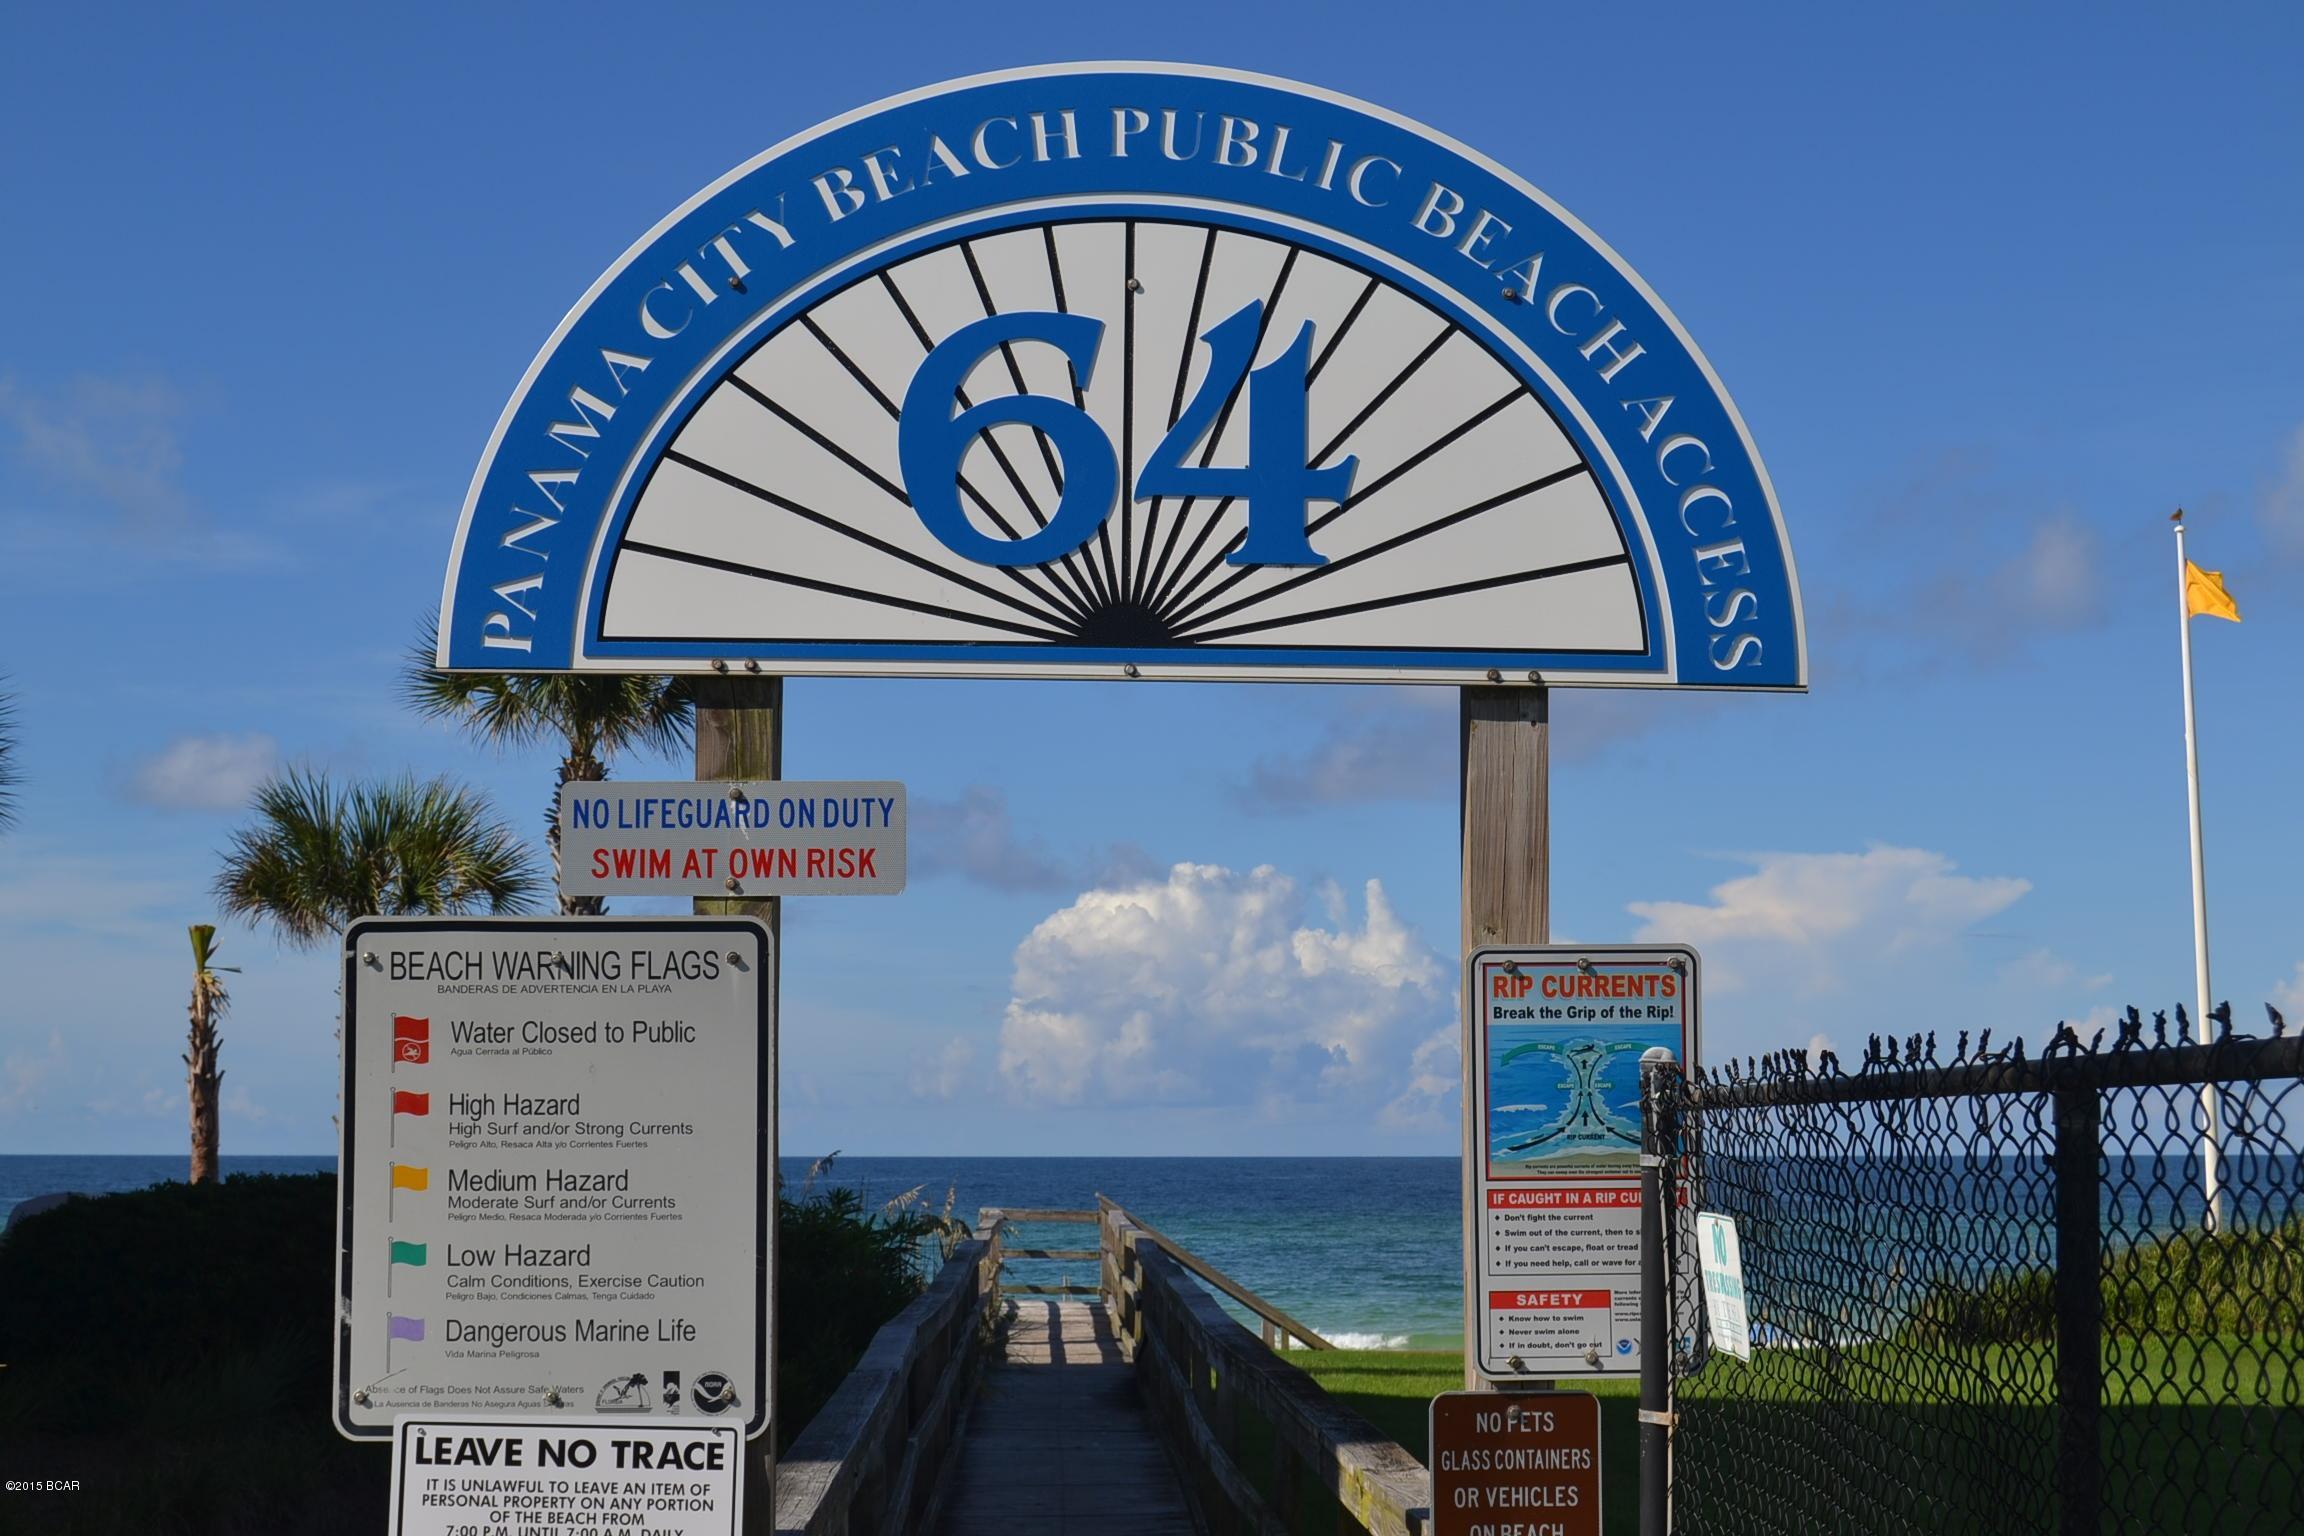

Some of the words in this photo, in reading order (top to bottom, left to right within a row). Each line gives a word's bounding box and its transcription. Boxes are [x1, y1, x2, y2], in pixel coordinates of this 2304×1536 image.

[482, 347, 655, 654] PANAMA
[638, 192, 797, 340] CITY
[812, 107, 1082, 223] BEACH
[1108, 106, 1403, 208] PUBLIC
[1409, 180, 1647, 384] BEACH
[1622, 394, 1763, 671] ACCESS
[898, 298, 1360, 568] 64
[572, 799, 610, 829] NO
[618, 798, 770, 829] LIFEGUARD
[779, 798, 815, 828] ON
[823, 797, 895, 828] DUTY
[591, 848, 671, 879] SWIM
[682, 848, 718, 879] AT
[729, 848, 797, 879] OWN
[807, 848, 877, 878] RISK
[390, 951, 483, 981] BEACH
[492, 950, 621, 980] WARNING
[631, 950, 720, 980] FLAGS
[437, 984, 499, 994] BANDERAS
[502, 984, 518, 994] DE
[520, 984, 599, 994] ADVERTENCIA
[601, 984, 618, 994] EN
[620, 984, 635, 994] LA
[637, 984, 672, 993] PLAYA
[1493, 975, 1534, 999] RIP
[1541, 975, 1677, 999] CURRENTS
[1493, 1006, 1535, 1019] Break
[1539, 1006, 1563, 1019] the
[1566, 1006, 1596, 1021] Grip
[1600, 1005, 1615, 1018] of
[1619, 1005, 1642, 1018] the
[1646, 1005, 1674, 1021] Rip!
[450, 1020, 515, 1044] Water
[522, 1020, 597, 1044] Closed
[604, 1021, 625, 1044] to
[633, 1020, 696, 1043] Public
[450, 1047, 473, 1057] Agua
[475, 1047, 510, 1056] Cerrada
[511, 1047, 520, 1056] al
[449, 1093, 495, 1122] High
[503, 1093, 580, 1116] Hazard
[449, 1122, 482, 1139] High
[487, 1121, 519, 1135] Surf
[522, 1121, 571, 1135] and/or
[575, 1121, 624, 1138] Strong
[629, 1121, 694, 1135] Currents
[448, 1140, 478, 1150] Peligro
[480, 1140, 498, 1149] Alto,
[500, 1140, 534, 1148] Resaca
[535, 1140, 553, 1148] Alta
[569, 1140, 614, 1148] Corrientes
[615, 1140, 648, 1148] Fuertes
[448, 1169, 537, 1192] Medium
[546, 1168, 629, 1192] Hazard
[448, 1195, 519, 1209] Moderate
[524, 1195, 556, 1209] Surf
[559, 1195, 608, 1209] and/or
[611, 1195, 676, 1208] Currents
[1493, 1193, 1505, 1205] IF
[1508, 1193, 1562, 1204] CAUGHT
[1566, 1193, 1579, 1204] IN
[1582, 1193, 1592, 1204] A
[1595, 1192, 1617, 1204] RIP
[447, 1213, 477, 1222] Peligro
[509, 1213, 542, 1221] Resaca
[544, 1213, 587, 1221] Moderada
[604, 1212, 648, 1221] Corrientes
[650, 1212, 683, 1221] Fuertes
[1504, 1214, 1525, 1222] Don't
[1527, 1214, 1546, 1223] fight
[1548, 1214, 1561, 1222] the
[1544, 1229, 1553, 1237] of
[1504, 1244, 1511, 1252] If
[1530, 1244, 1550, 1252] can't
[1711, 1224, 1727, 1267] NO
[447, 1244, 496, 1267] Low
[505, 1244, 590, 1267] Hazard
[1513, 1261, 1528, 1269] you
[447, 1274, 486, 1288] Calm
[491, 1274, 572, 1289] Conditions,
[578, 1274, 642, 1288] Exercise
[647, 1274, 705, 1288] Caution
[1516, 1293, 1584, 1306] SAFETY
[446, 1319, 567, 1348] Dangerous
[575, 1319, 650, 1342] Marine
[658, 1318, 696, 1341] Life
[445, 1350, 464, 1358] Vida
[467, 1350, 497, 1358] Marina
[499, 1350, 540, 1360] Peligrosa
[1577, 1342, 1587, 1350] go
[408, 1385, 418, 1394] of
[420, 1385, 445, 1395] Flags
[447, 1385, 472, 1394] Does
[474, 1385, 491, 1394] Not
[493, 1385, 525, 1394] Assure
[1476, 1412, 1501, 1433] NO
[1507, 1411, 1555, 1433] PETS
[415, 1436, 523, 1467] LEAVE
[537, 1439, 597, 1469] NO
[611, 1440, 725, 1471] TRACE
[1441, 1450, 1491, 1471] GLASS
[1495, 1448, 1591, 1470] CONTAINERS
[426, 1479, 439, 1491] IT
[444, 1479, 456, 1491] IS
[461, 1479, 544, 1493] UNLAWFUL
[549, 1481, 569, 1494] TO
[574, 1481, 619, 1495] LEAVE
[623, 1482, 646, 1495] AN
[651, 1483, 685, 1496] ITEM
[690, 1483, 711, 1497] OF
[1454, 1487, 1479, 1509] OR
[1485, 1485, 1579, 1508] VEHICLES
[422, 1494, 498, 1508] PERSONAL
[503, 1495, 576, 1509] PROPERTY
[580, 1497, 605, 1510] ON
[609, 1498, 642, 1510] ANY
[647, 1498, 714, 1512] PORTION
[490, 1510, 510, 1523] OF
[515, 1511, 542, 1524] THE
[547, 1512, 597, 1525] BEACH
[602, 1513, 645, 1526] FROM
